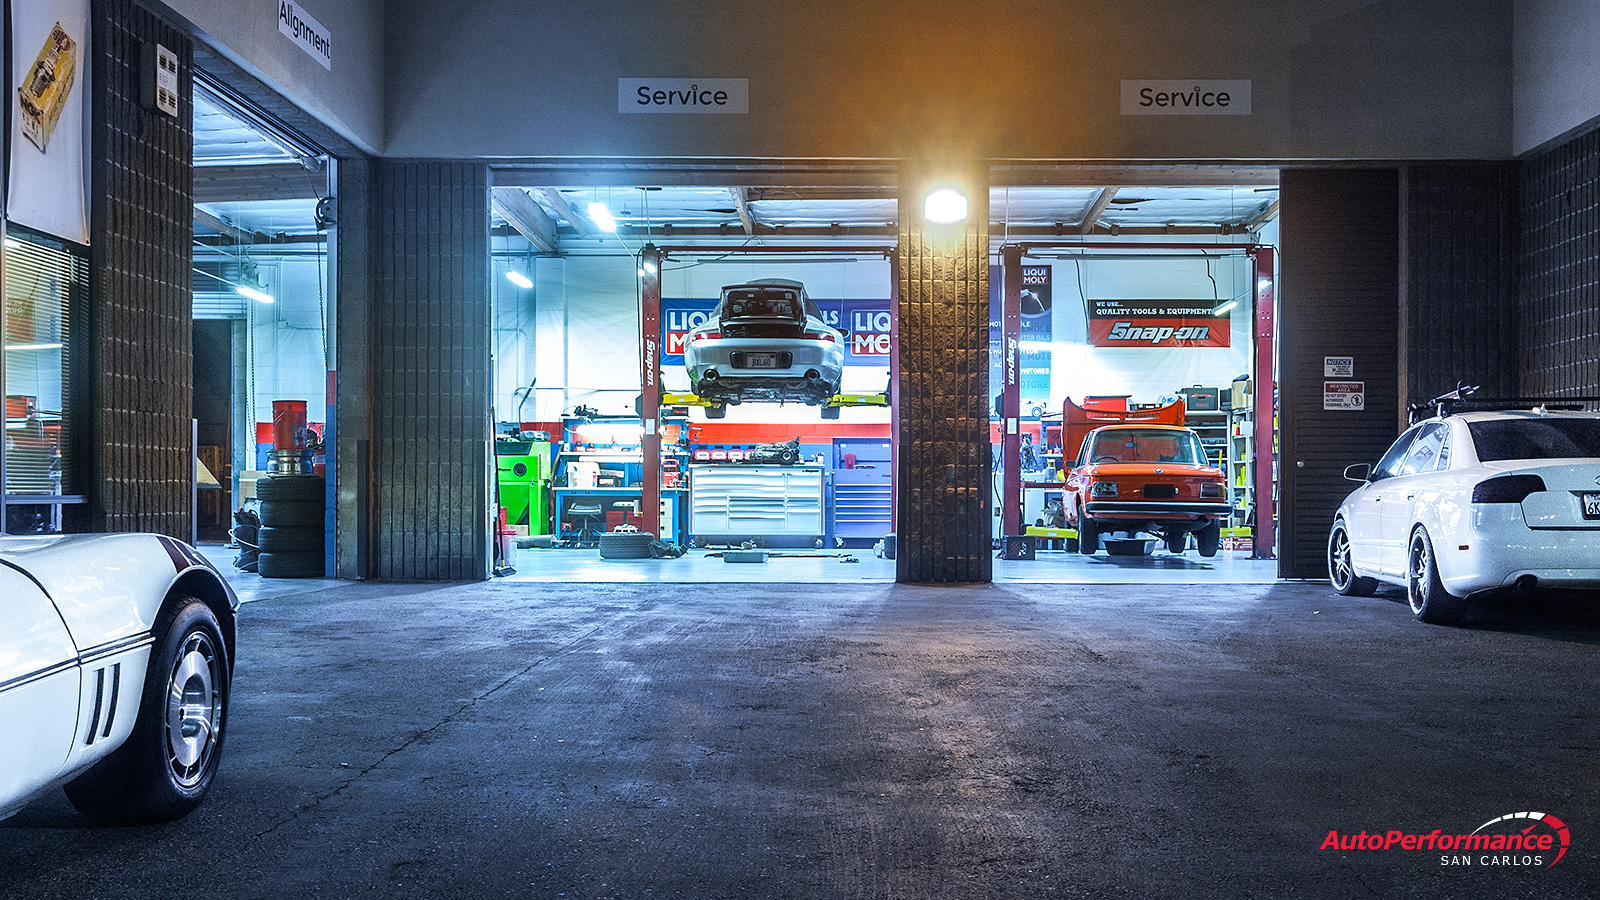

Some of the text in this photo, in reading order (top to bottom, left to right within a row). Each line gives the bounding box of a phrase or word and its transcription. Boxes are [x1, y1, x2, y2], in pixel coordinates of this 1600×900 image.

[279, 0, 331, 60] Alignment
[636, 84, 728, 105] Service
[1139, 86, 1231, 107] Service
[1023, 268, 1046, 276] LIQUI
[1096, 308, 1131, 316] QUALITY
